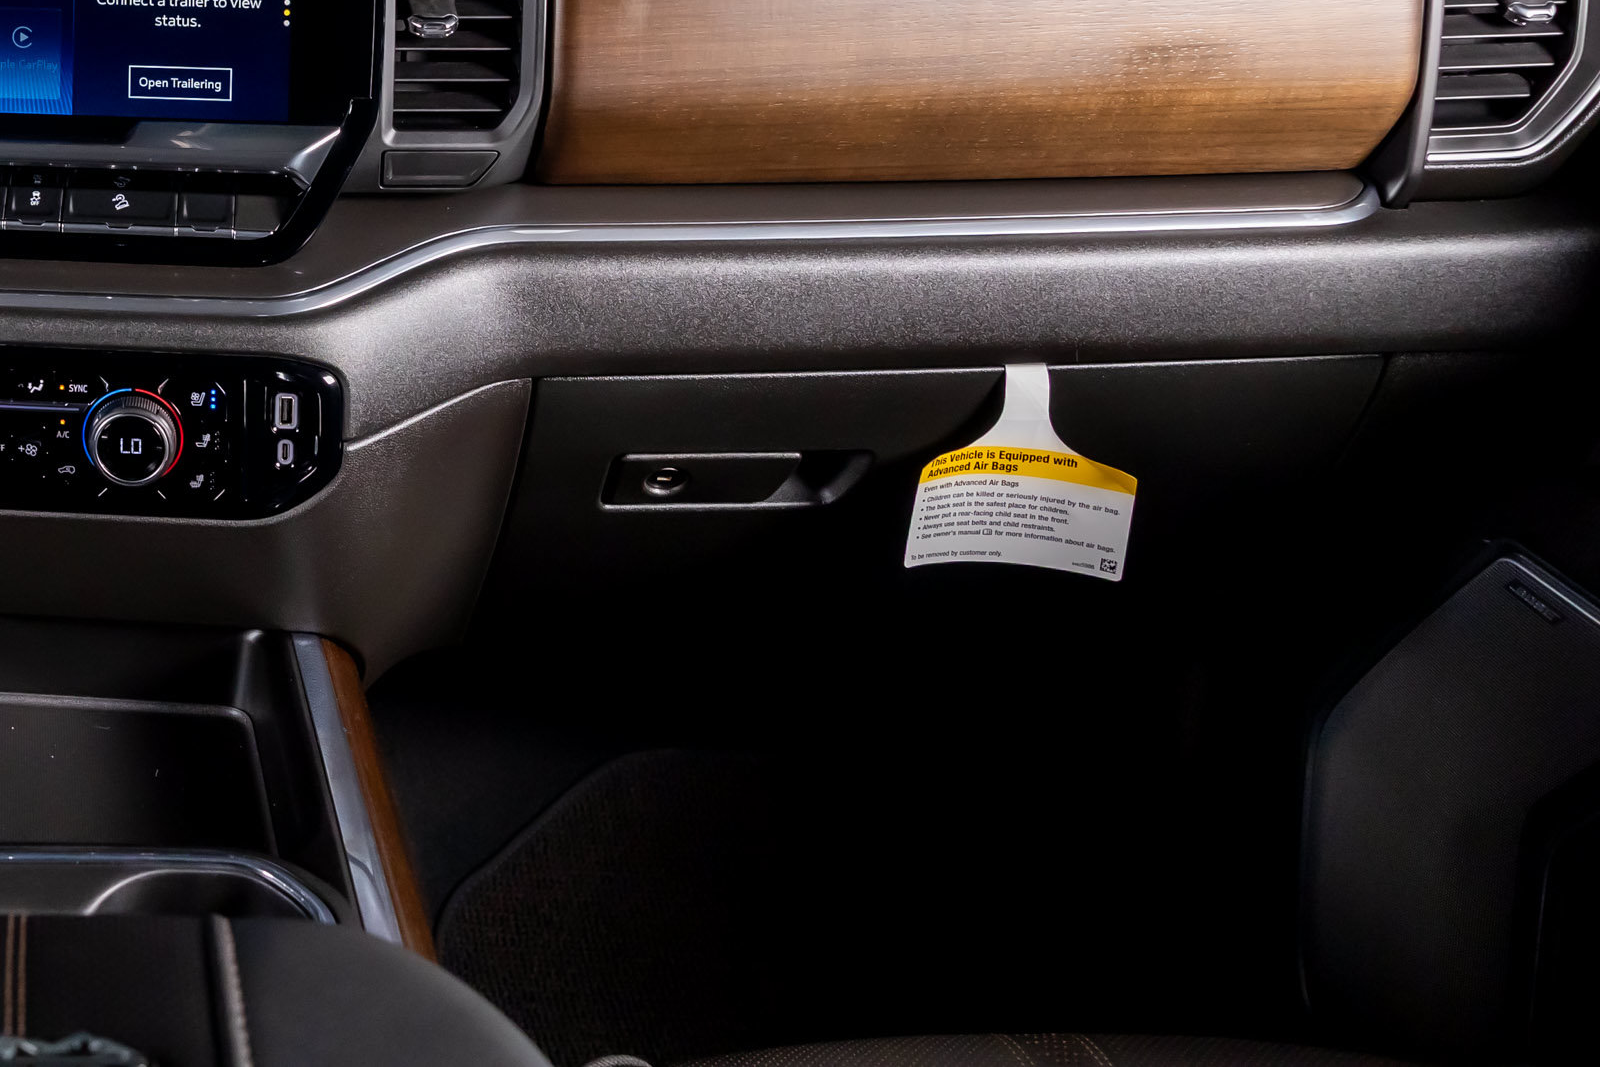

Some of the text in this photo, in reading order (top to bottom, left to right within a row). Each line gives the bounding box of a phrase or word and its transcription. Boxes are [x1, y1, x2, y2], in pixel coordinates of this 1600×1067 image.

[154, 14, 202, 28] status.
[18, 58, 59, 73] CarPlay
[138, 76, 222, 92] Open Trailering
[68, 383, 89, 394] SYNC
[56, 430, 70, 439] A/C
[930, 449, 1078, 469] This Vehicle is Equipped with
[927, 461, 1019, 478] Advanced Air Bags
[923, 485, 938, 493] Even
[939, 482, 953, 490] with
[953, 479, 987, 487] Advanced
[1001, 480, 1019, 489] Bags
[925, 504, 936, 512] The
[1007, 501, 1027, 510] place
[1028, 503, 1038, 511] for
[1039, 504, 1070, 515] children.
[926, 493, 951, 503] Children
[1005, 492, 1038, 502] seriously
[1039, 494, 1065, 505] injured
[1067, 499, 1077, 508] by
[1078, 501, 1091, 510] the
[1092, 504, 1103, 512] air
[1104, 506, 1121, 516] bag.
[941, 512, 952, 520] put
[957, 510, 994, 518] rear-facing
[1029, 512, 1036, 520] in
[1037, 514, 1049, 522] the
[1050, 516, 1070, 525] front.
[922, 522, 943, 531] Always
[1002, 520, 1020, 528] child
[1020, 522, 1056, 533] restraints.
[932, 530, 957, 538] owner's
[1005, 530, 1023, 538] more
[1023, 531, 1063, 544] information
[1064, 538, 1085, 547] about
[1085, 541, 1095, 549] air
[1096, 543, 1116, 554] bags.
[925, 550, 950, 559] removed
[950, 550, 958, 558] by
[988, 550, 1003, 558] only.
